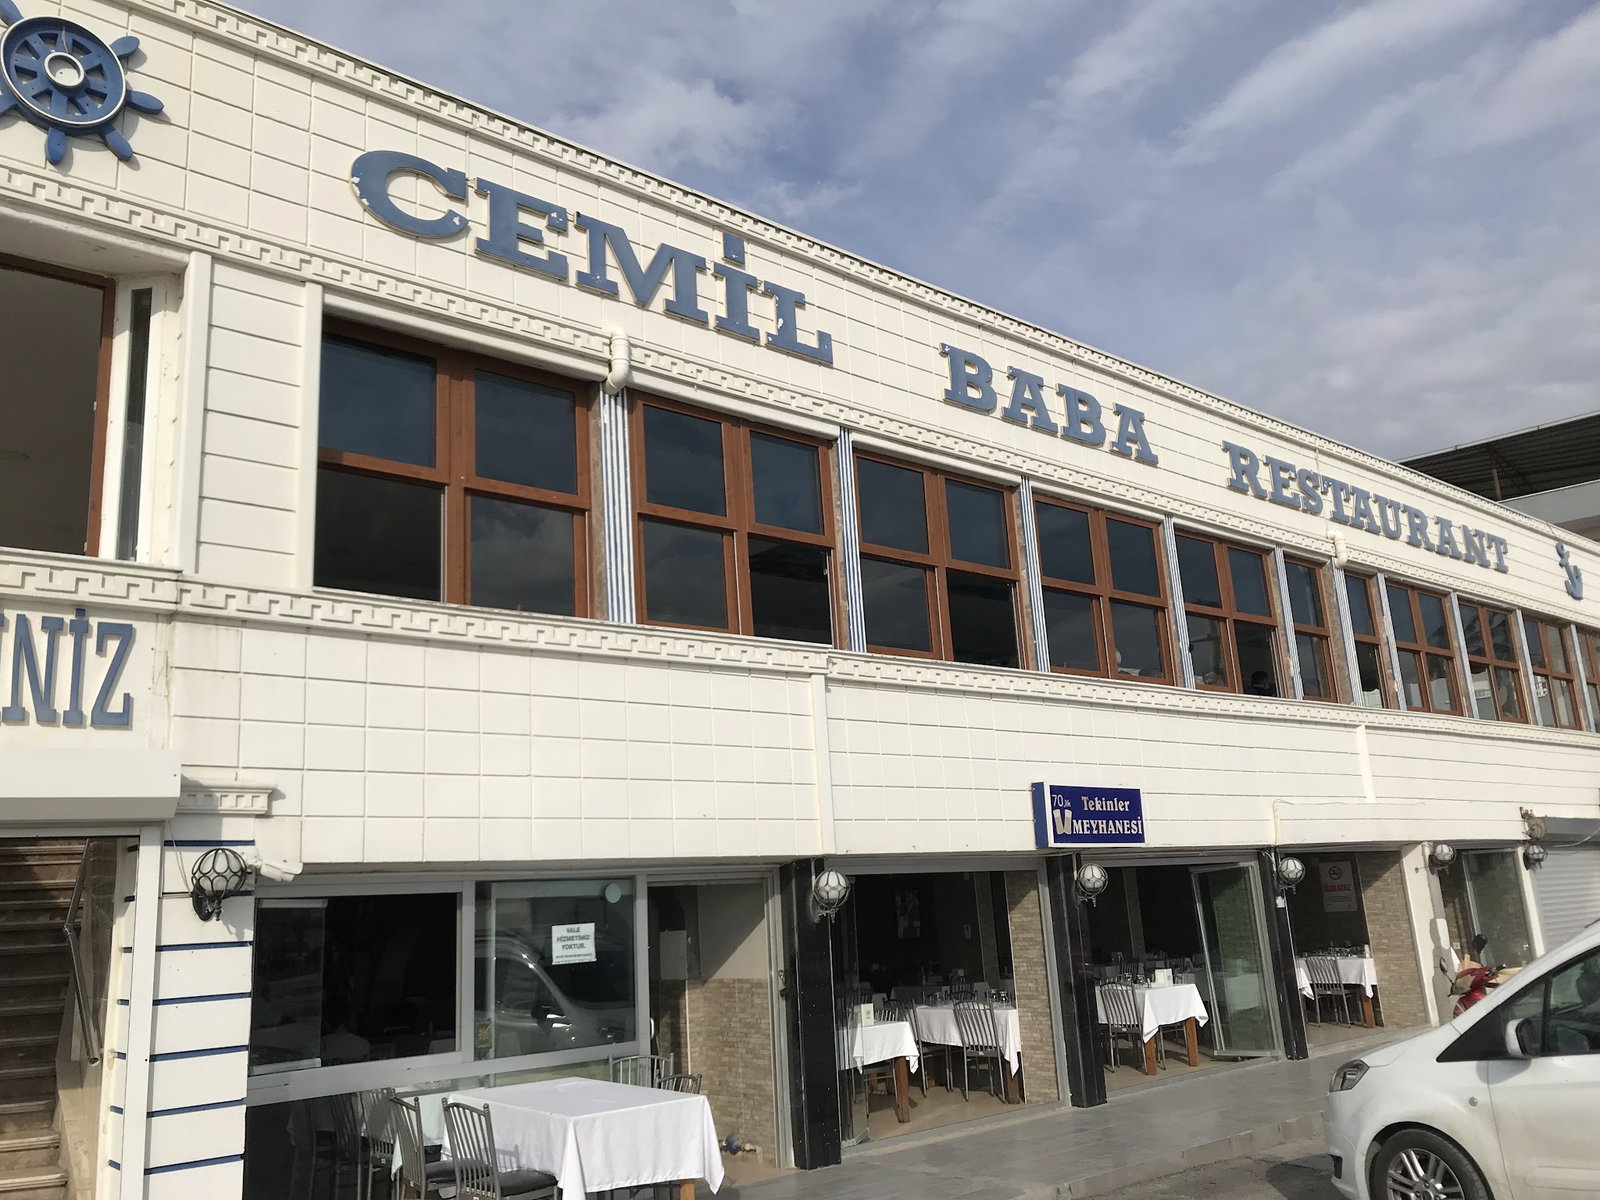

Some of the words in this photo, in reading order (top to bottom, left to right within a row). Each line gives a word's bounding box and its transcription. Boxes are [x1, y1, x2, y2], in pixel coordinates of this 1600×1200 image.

[350, 149, 833, 365] CEMİL
[939, 342, 1158, 466] BABA
[1222, 440, 1509, 573] RESTAURANT
[0, 608, 133, 725] NİZ
[1073, 816, 1143, 834] MEYHANESİ
[1081, 796, 1130, 811] Tekinler
